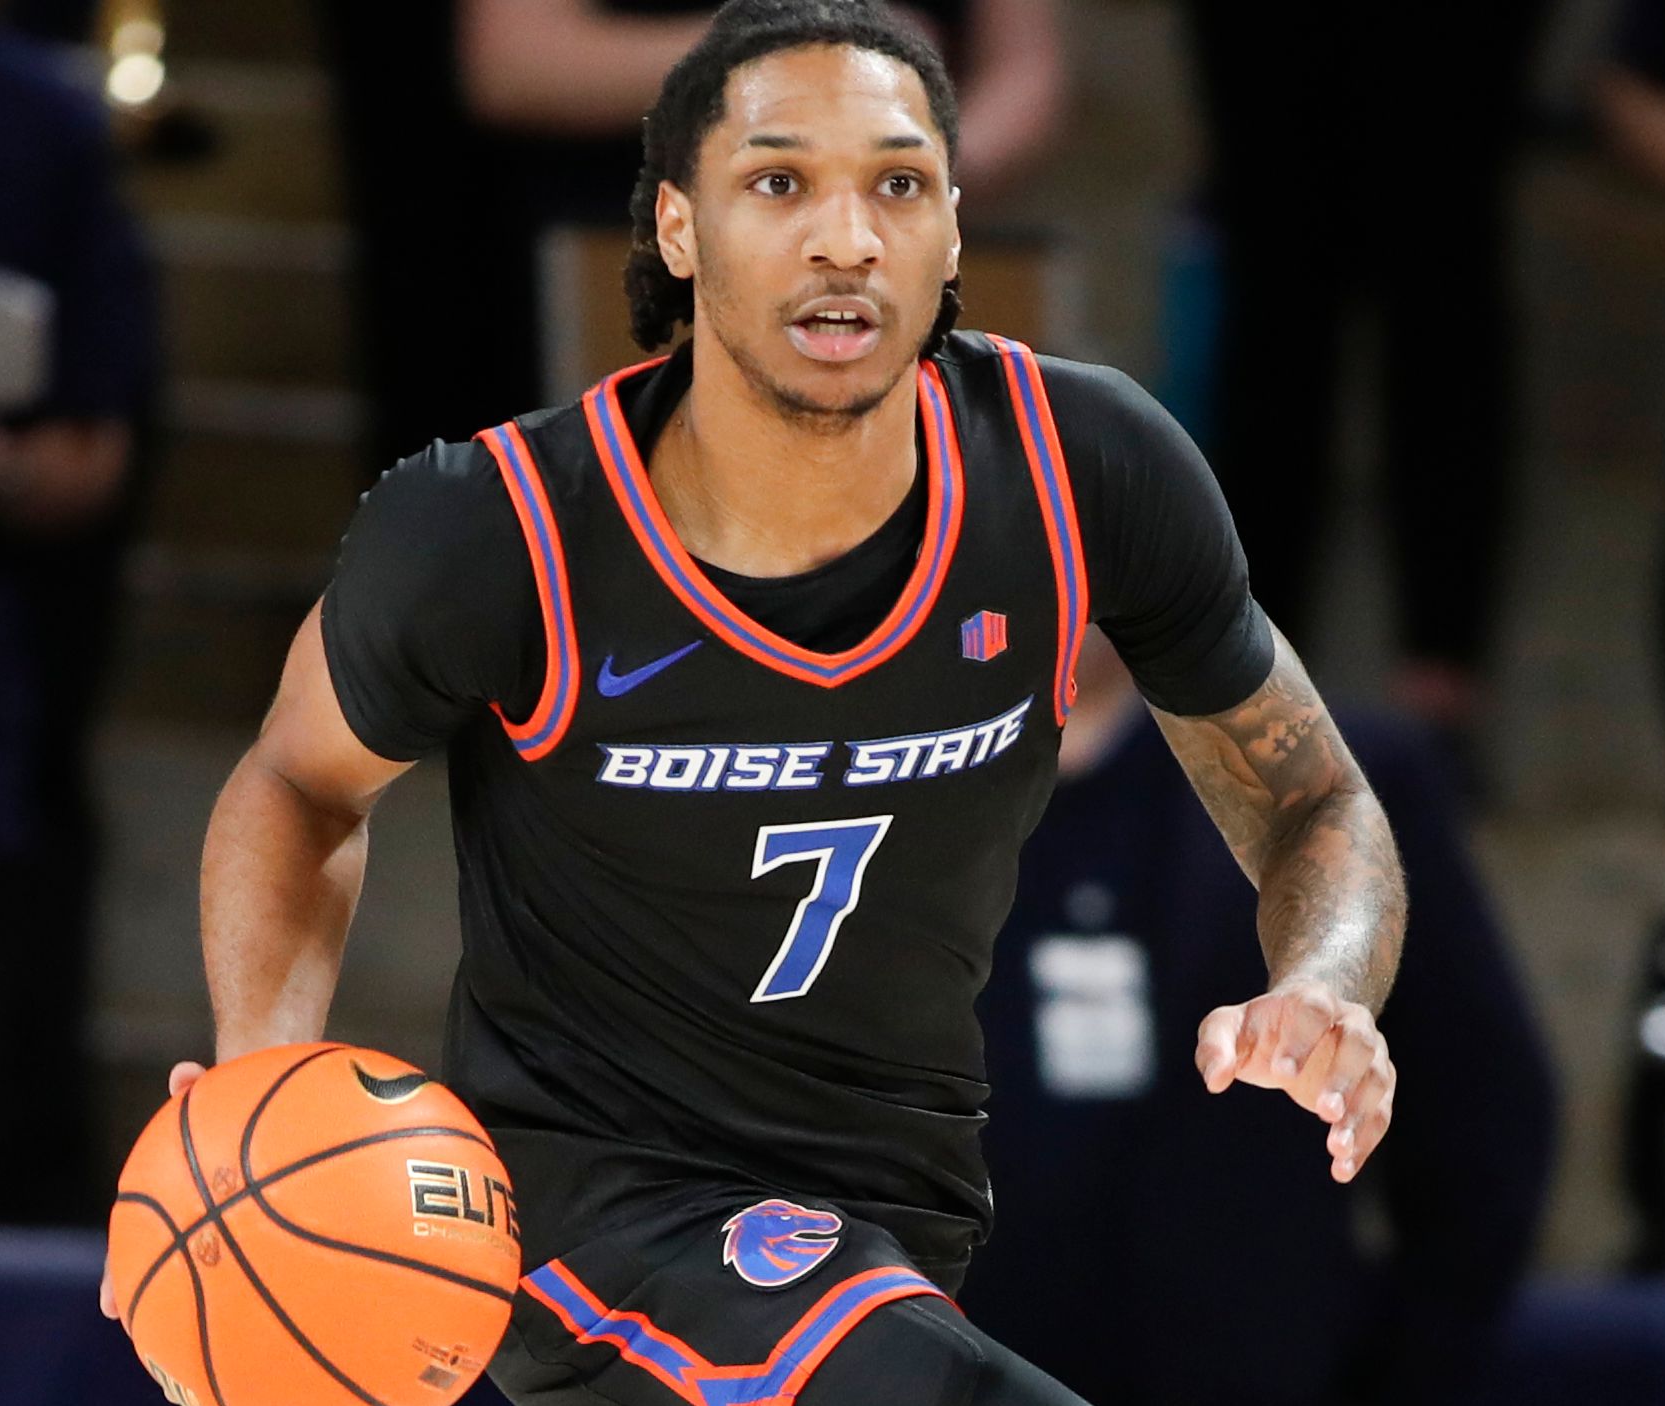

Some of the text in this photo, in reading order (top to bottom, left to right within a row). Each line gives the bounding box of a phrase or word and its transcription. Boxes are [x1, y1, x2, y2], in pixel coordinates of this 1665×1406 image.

[596, 693, 1034, 791] BOISE STATE
[749, 814, 895, 1003] 7
